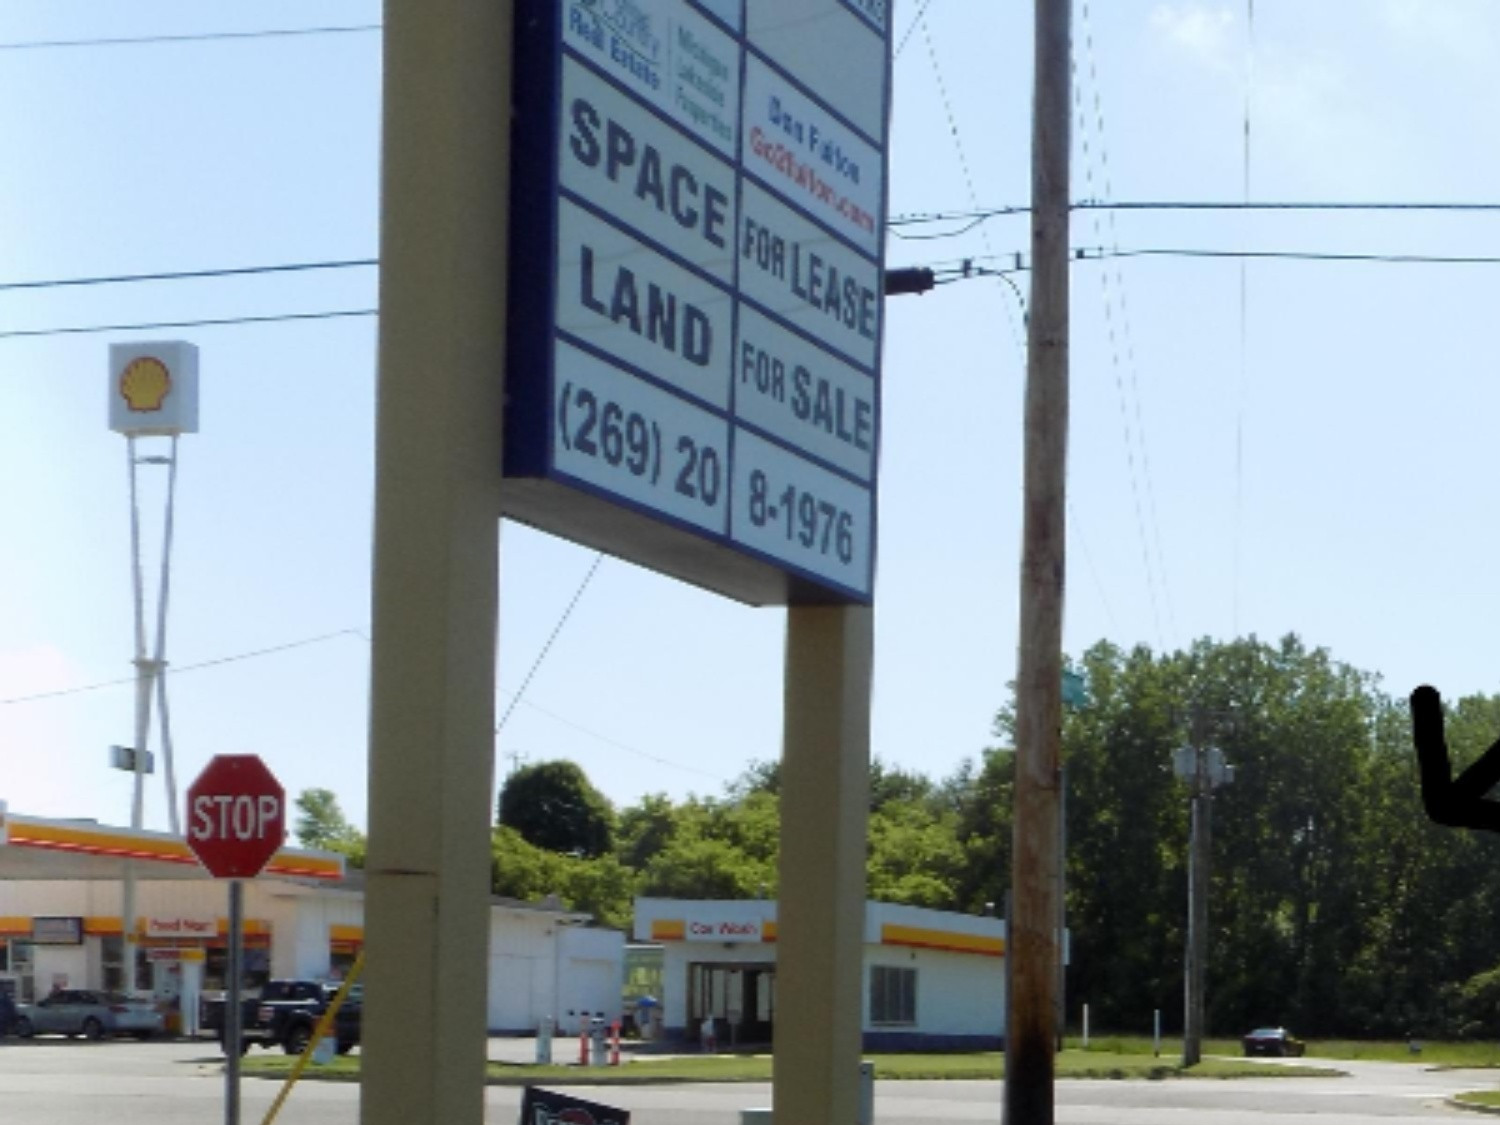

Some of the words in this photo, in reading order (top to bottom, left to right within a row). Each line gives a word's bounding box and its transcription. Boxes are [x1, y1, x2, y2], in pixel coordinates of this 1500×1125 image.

[569, 97, 729, 250] SPACE
[742, 215, 786, 283] FOR
[790, 241, 875, 341] LEASE
[580, 244, 713, 367] LAND
[741, 340, 785, 403] FOR
[790, 364, 873, 452] SALE
[558, 381, 662, 487] (269)
[674, 435, 720, 507] 20
[748, 468, 854, 565] 8-1976
[192, 795, 279, 841] STOP
